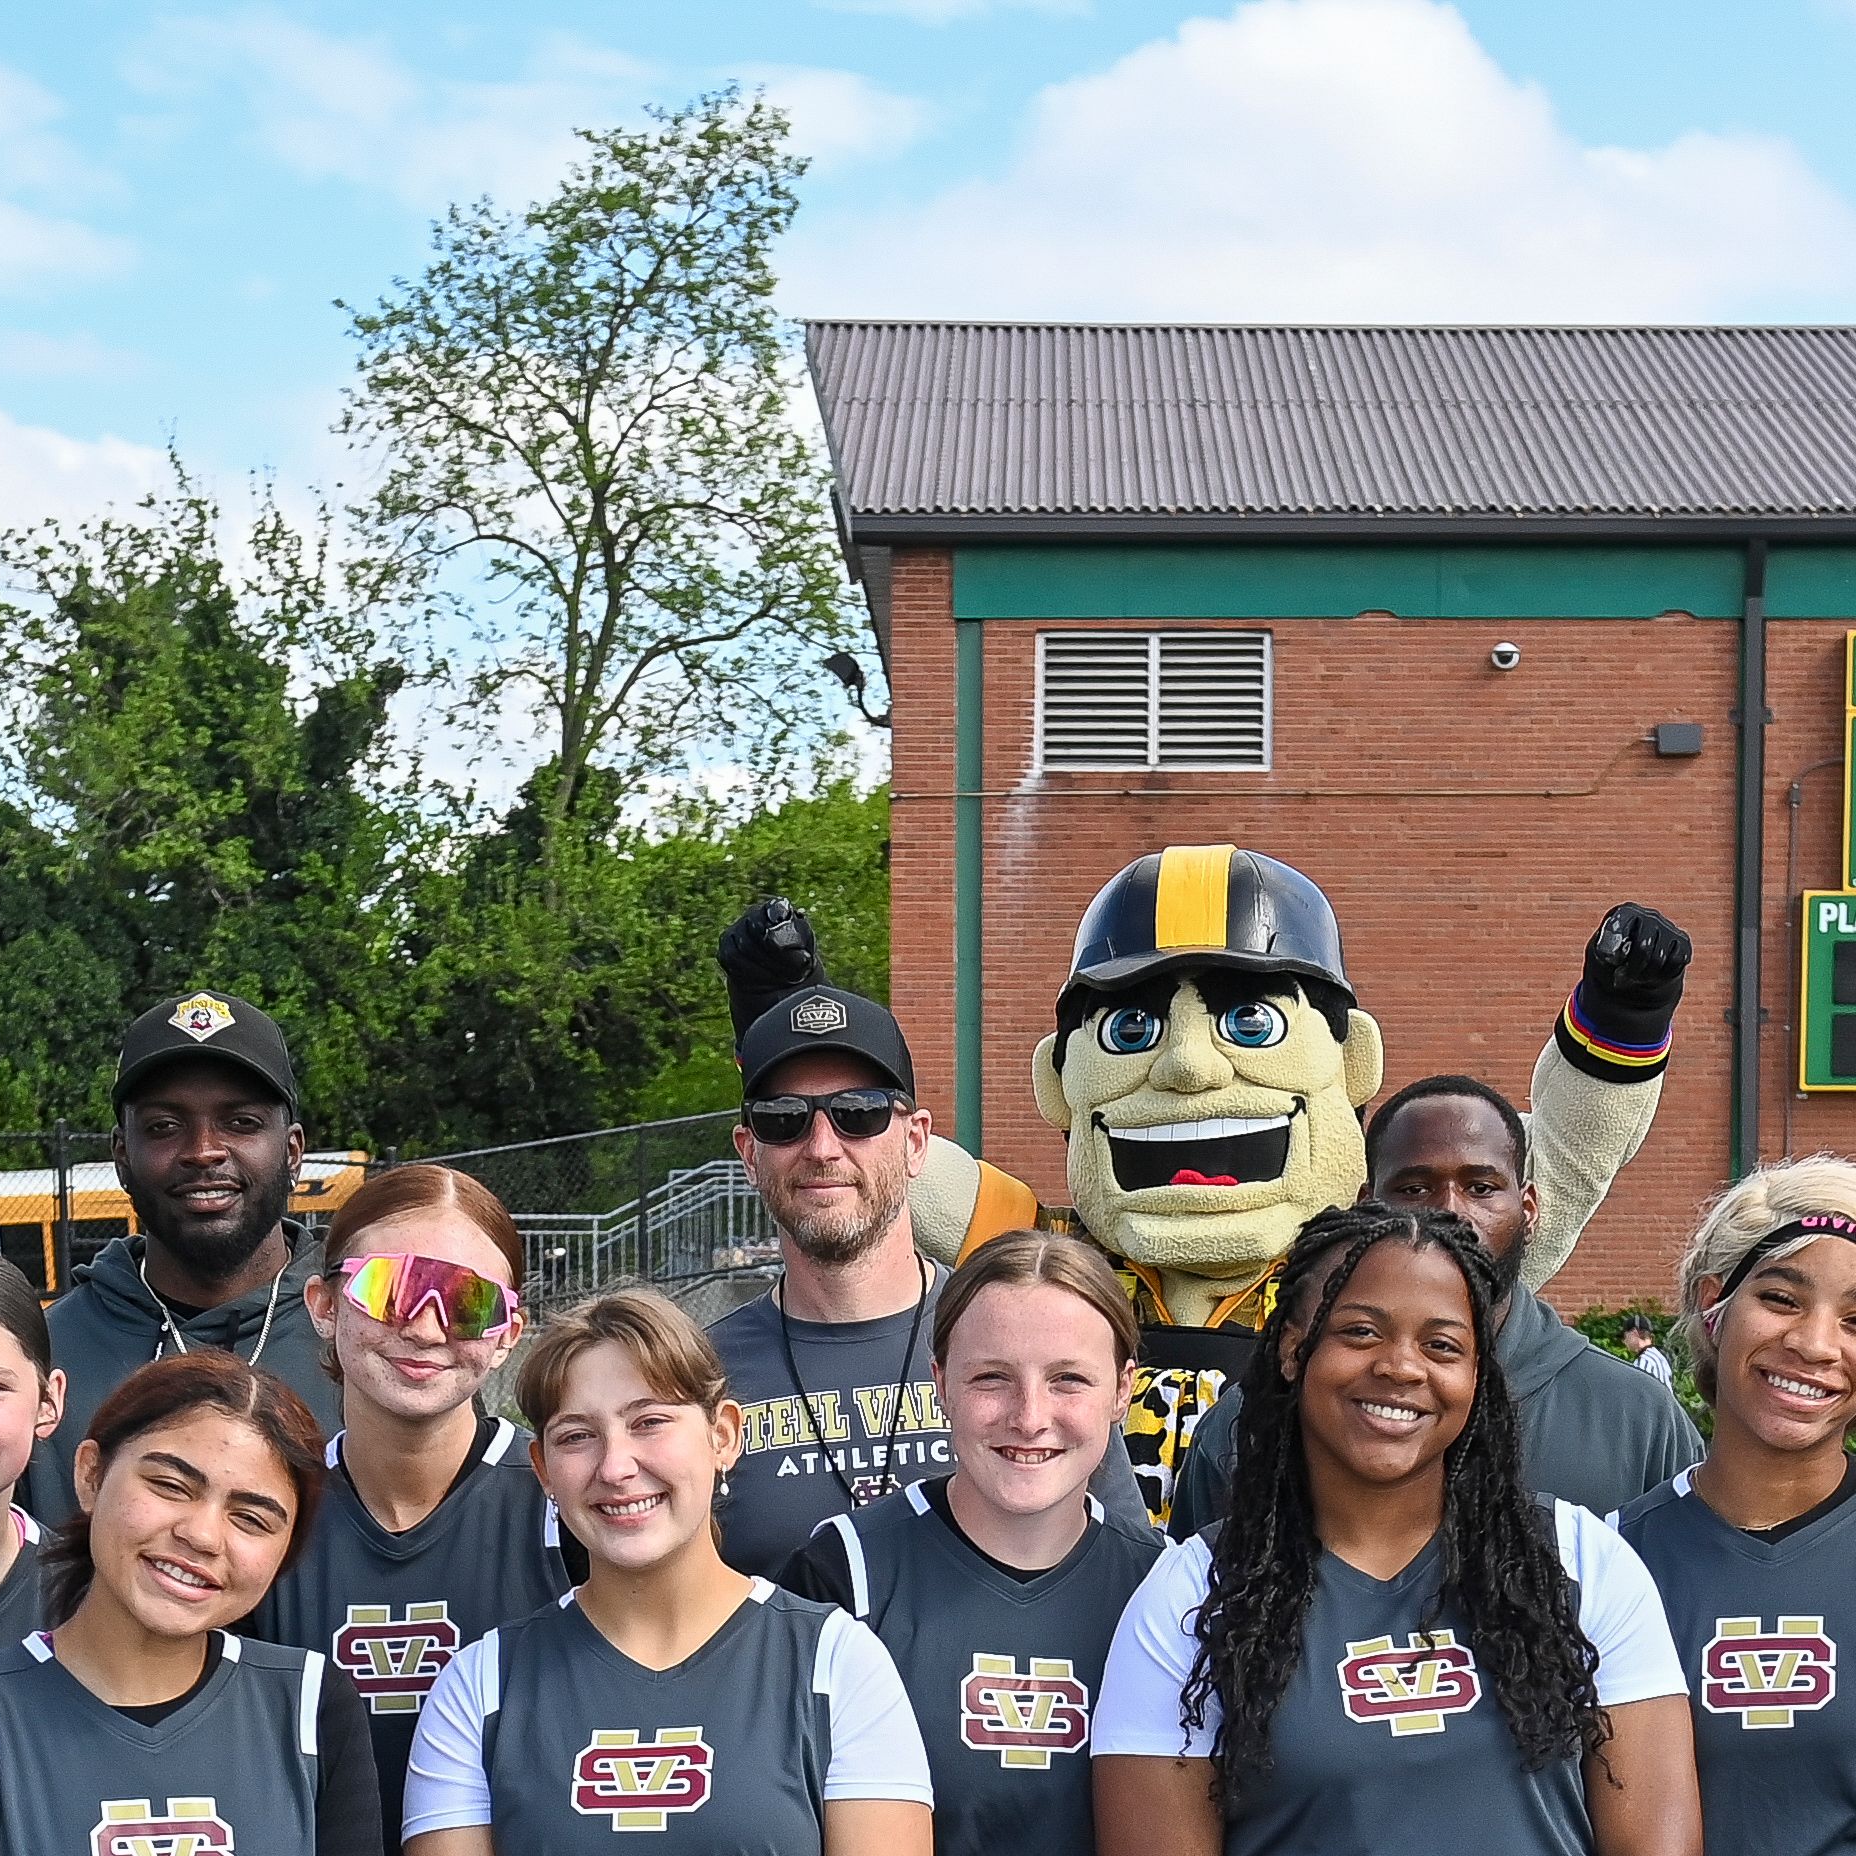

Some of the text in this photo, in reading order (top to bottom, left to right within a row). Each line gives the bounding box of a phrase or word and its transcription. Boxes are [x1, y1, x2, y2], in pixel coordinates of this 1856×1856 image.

[742, 1381, 952, 1455] TEEL VAL
[776, 1439, 959, 1478] ATHLETIC
